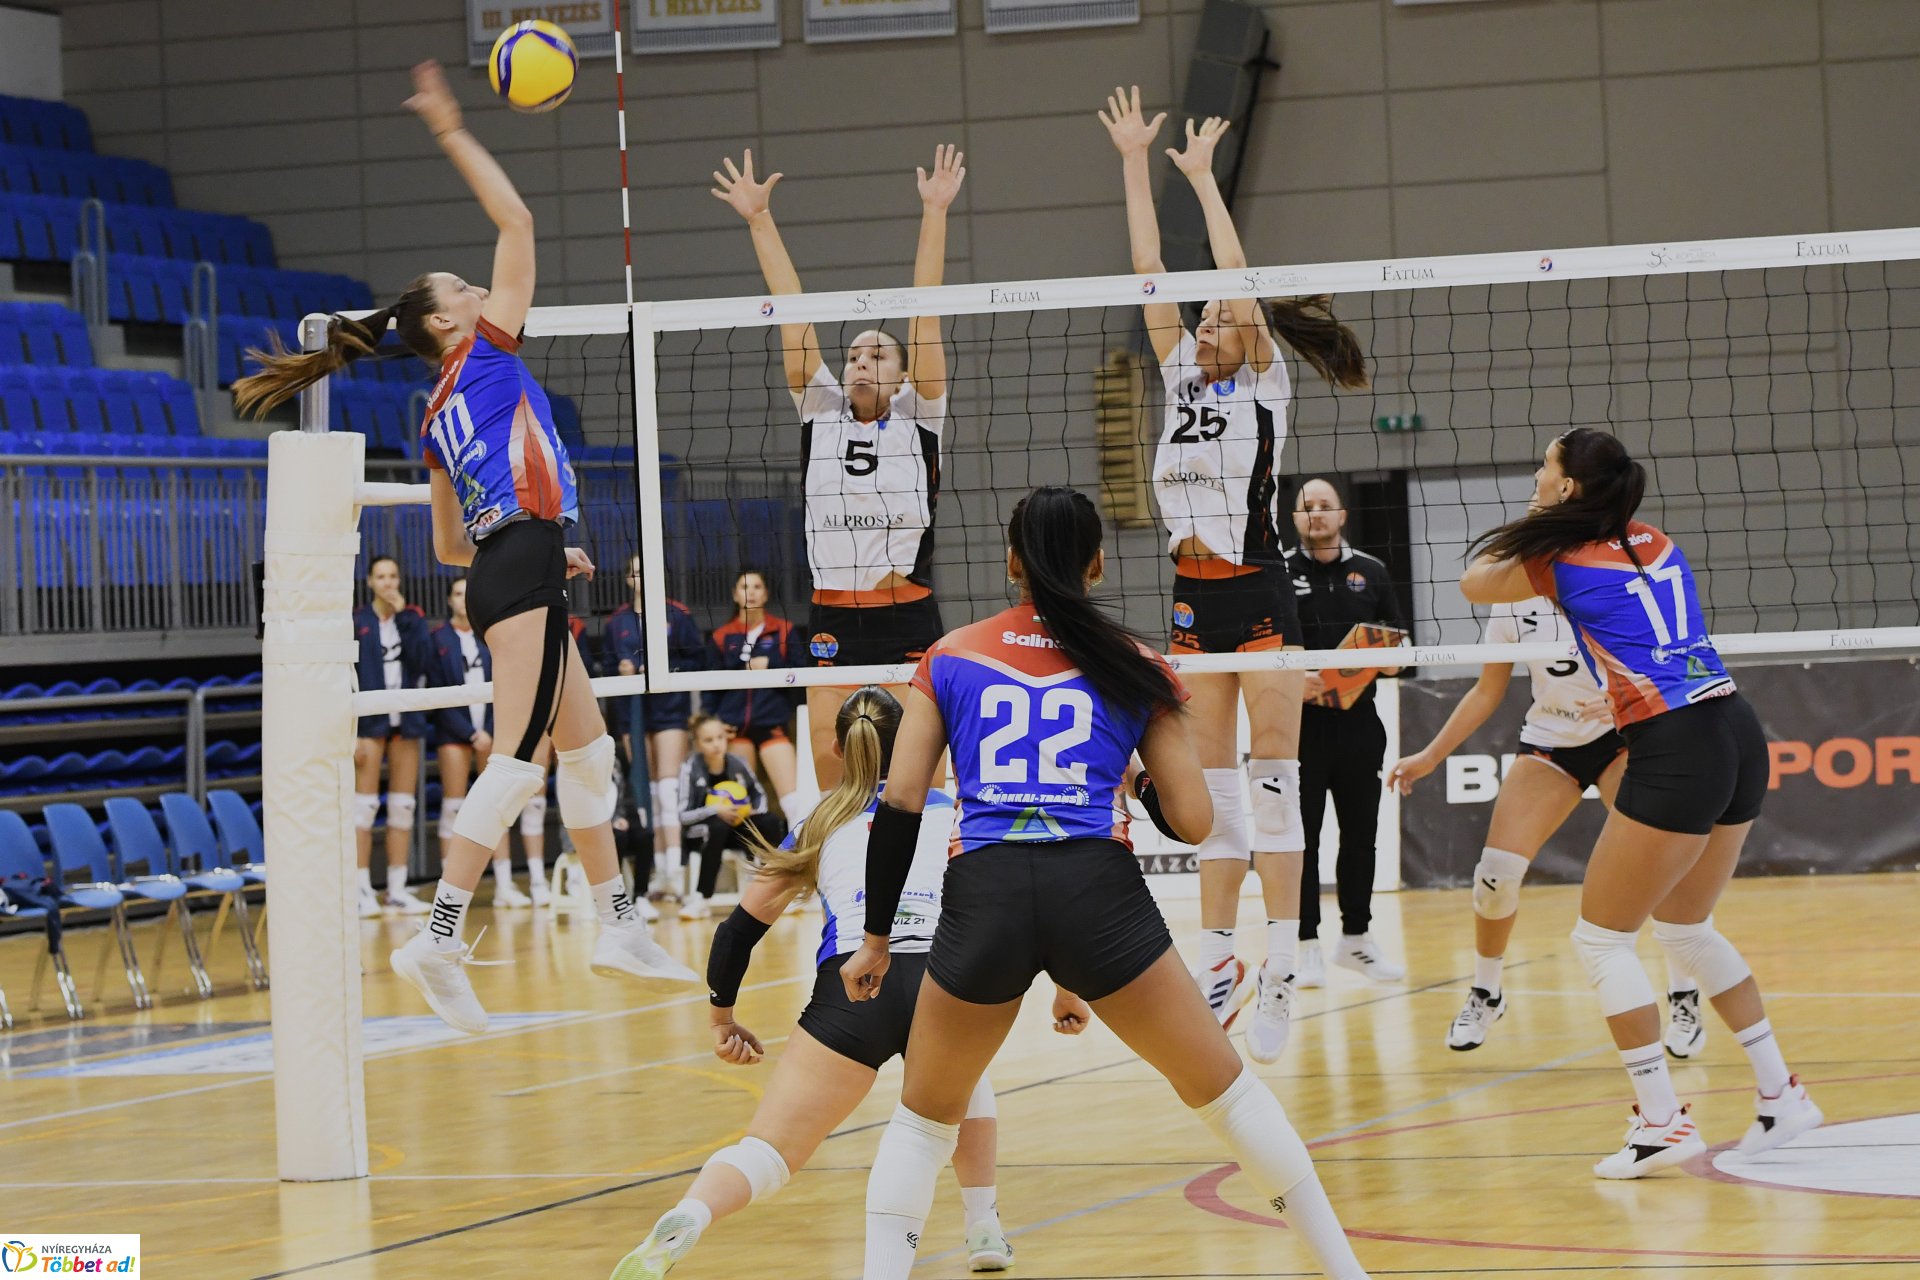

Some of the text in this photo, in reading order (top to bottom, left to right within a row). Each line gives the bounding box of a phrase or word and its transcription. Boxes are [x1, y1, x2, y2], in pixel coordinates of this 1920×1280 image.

[1797, 241, 1850, 257] FATUM
[1382, 266, 1435, 282] FATUM
[989, 288, 1041, 304] FATUM
[429, 392, 475, 478] 10
[1170, 406, 1230, 443] 25
[844, 439, 879, 476] 5
[823, 513, 905, 528] ALPROSYS
[1625, 565, 1688, 646] 17
[979, 684, 1093, 785] 22
[1767, 736, 1920, 791] POR
